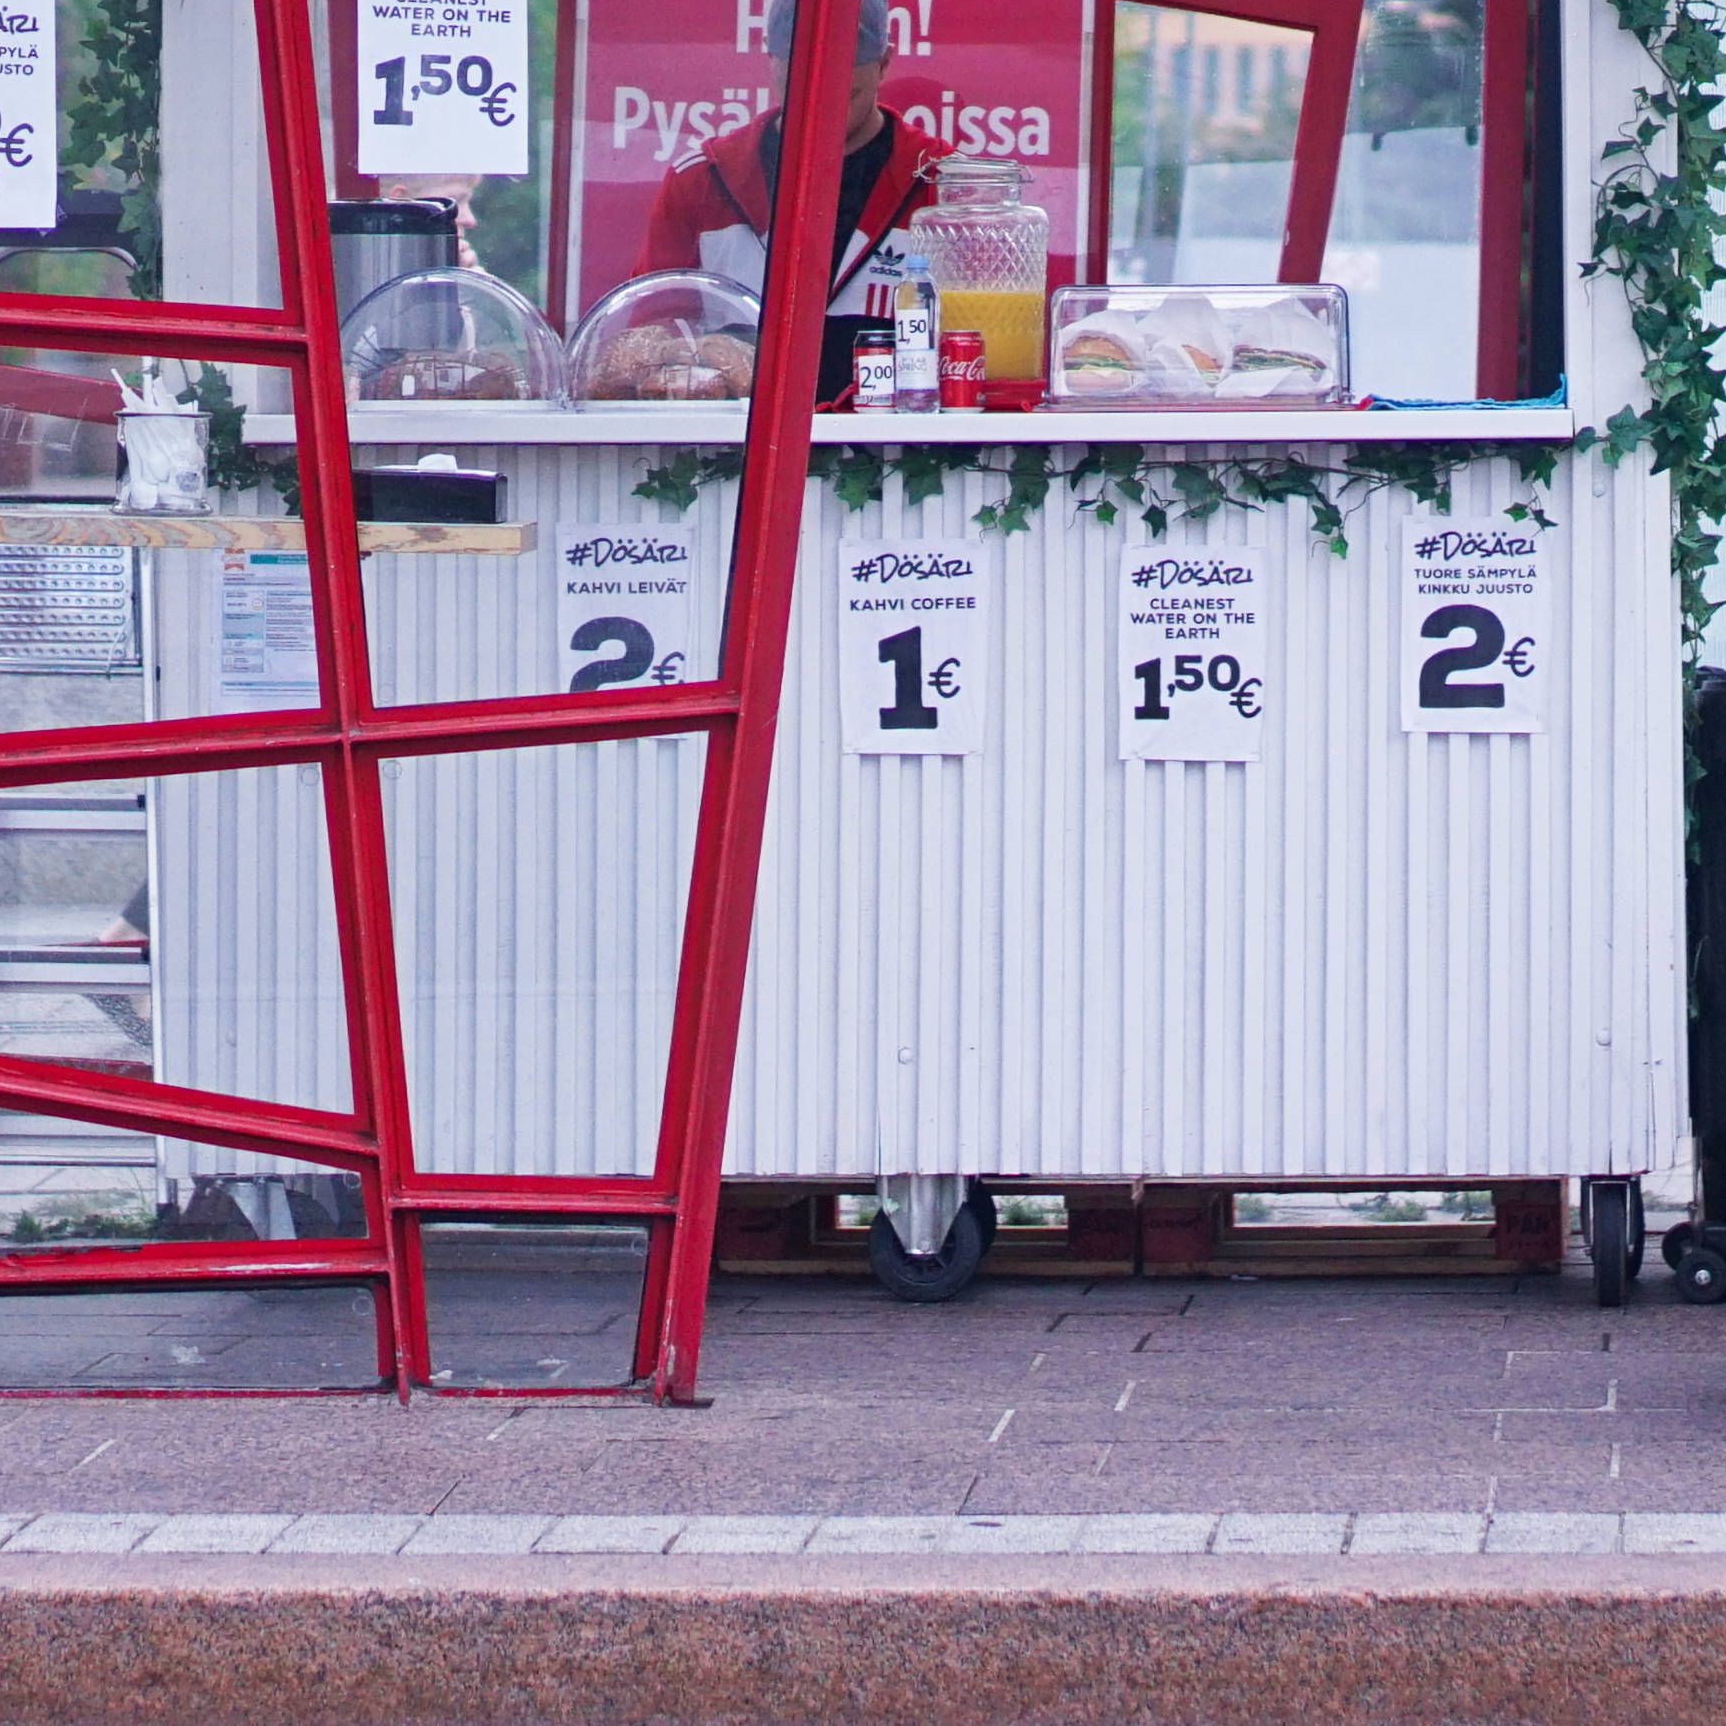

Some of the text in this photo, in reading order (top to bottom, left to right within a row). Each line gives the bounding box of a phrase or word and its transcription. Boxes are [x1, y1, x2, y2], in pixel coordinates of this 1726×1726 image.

[372, 5, 512, 23] WATER ON THE
[410, 23, 472, 38] EARTH
[897, 319, 927, 345] 1,50
[860, 365, 894, 391] 2,00
[1413, 563, 1538, 580] TUORE SÄMPYLÄ
[566, 577, 688, 595] KAHVI LEIVÄT
[1417, 582, 1534, 595] KINKKU JUUSTO
[849, 596, 977, 612] KAHVI COFFEE
[1149, 597, 1236, 611] CLEANEST
[1130, 612, 1256, 626] WATER ON THE
[1164, 626, 1221, 640] EARTH
[1418, 603, 1536, 709] 2€
[877, 625, 962, 730] 1€
